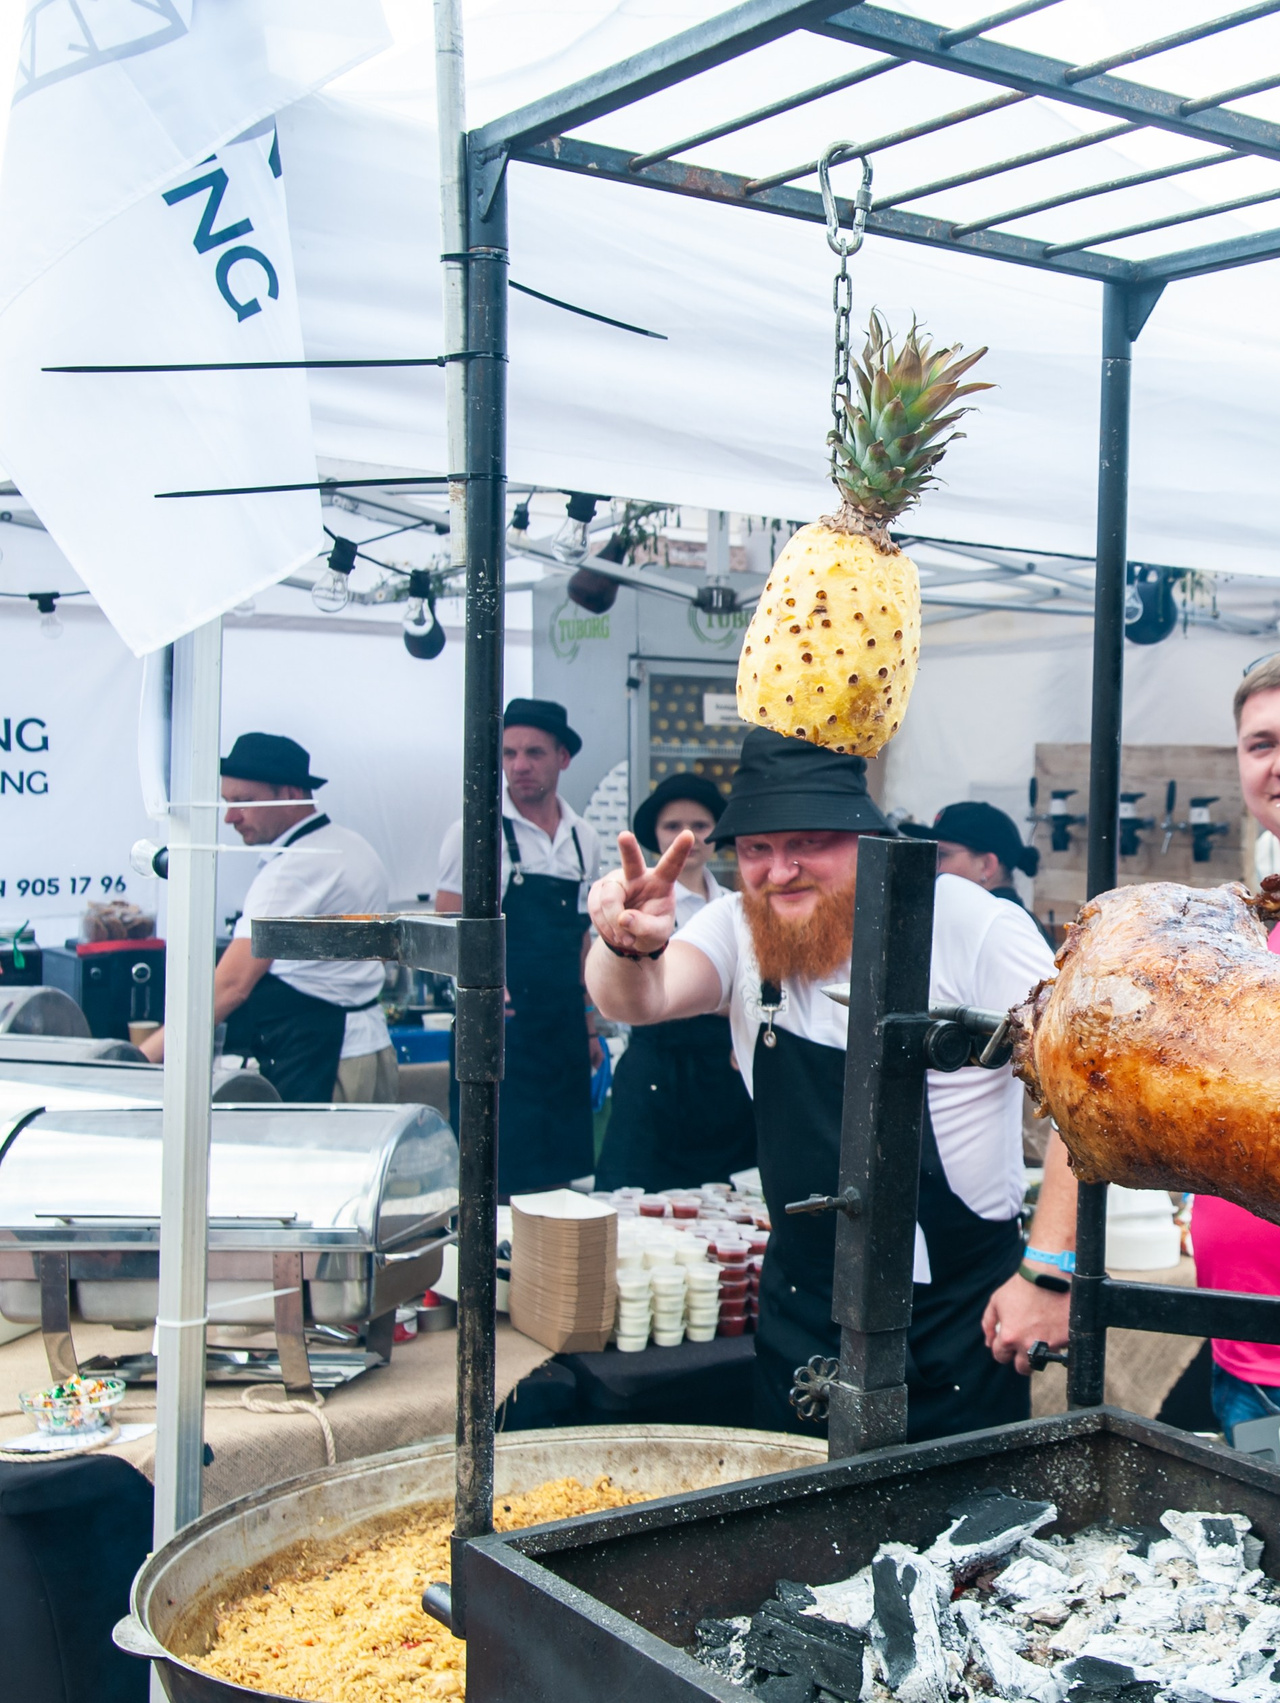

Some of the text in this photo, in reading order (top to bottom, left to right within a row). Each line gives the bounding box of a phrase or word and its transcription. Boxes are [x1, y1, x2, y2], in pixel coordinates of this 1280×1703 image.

[161, 153, 280, 323] NG
[558, 614, 610, 643] TUBORG
[0, 770, 49, 794] NG
[17, 878, 59, 897] 905
[70, 876, 91, 895] 17
[100, 875, 127, 894] 96
